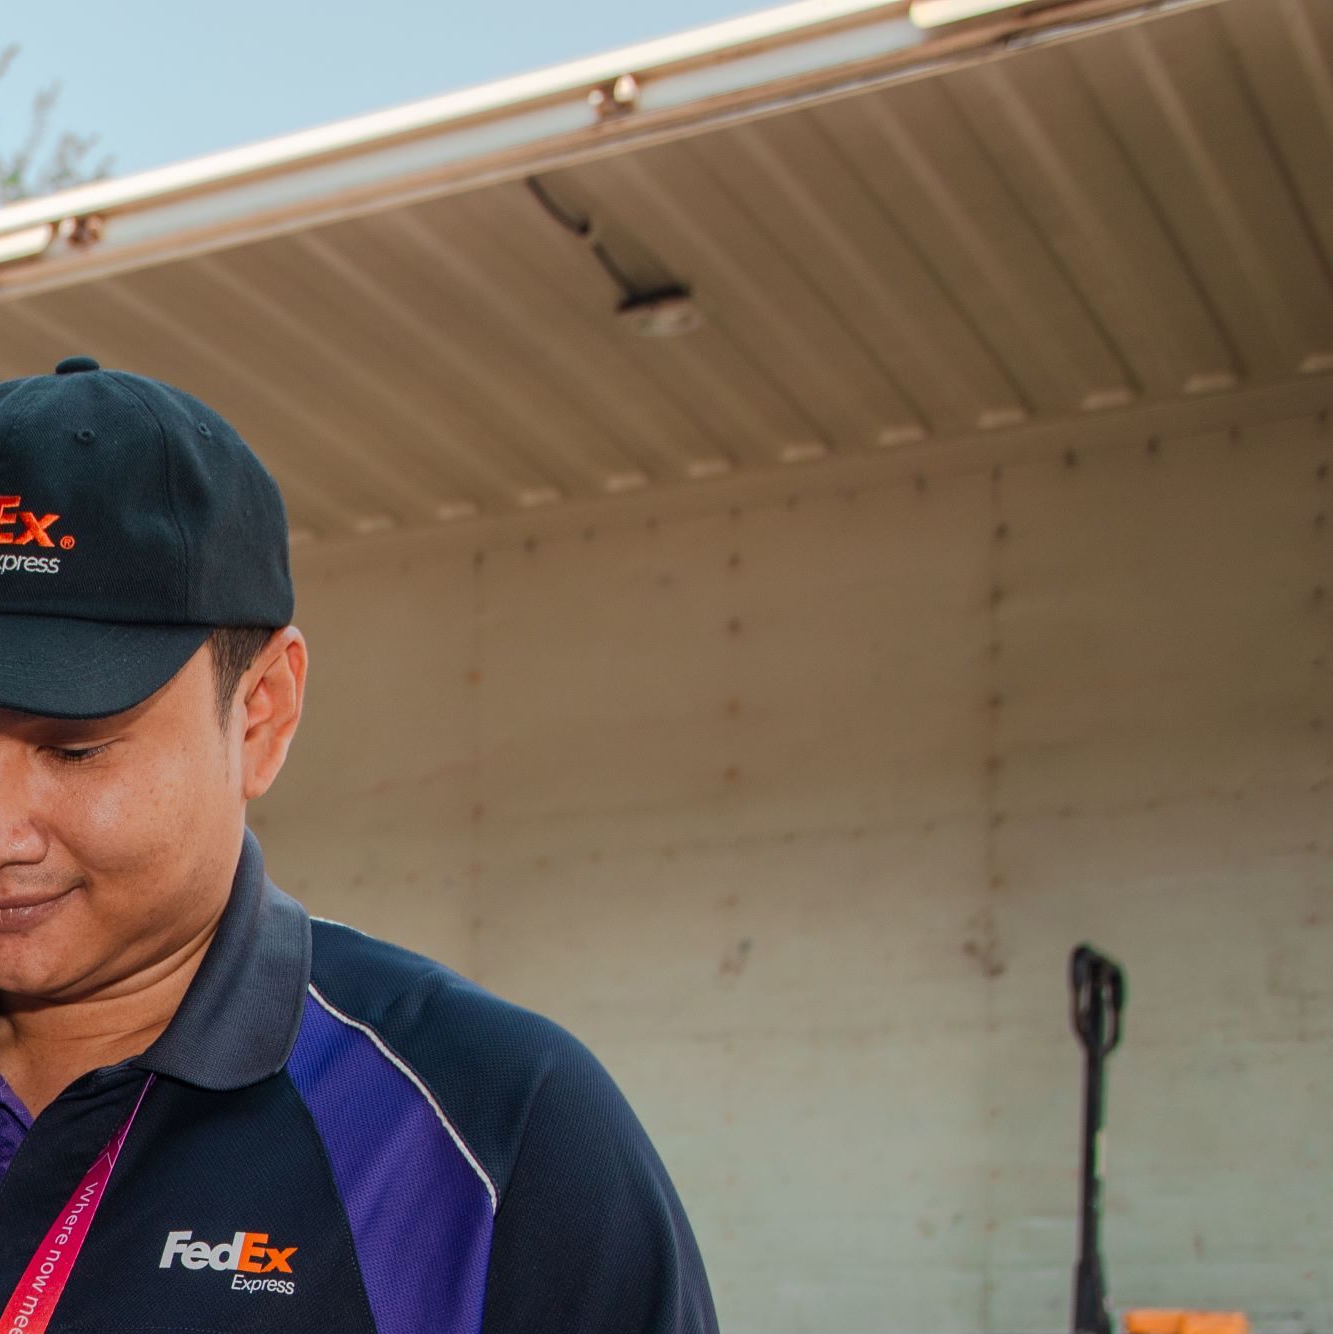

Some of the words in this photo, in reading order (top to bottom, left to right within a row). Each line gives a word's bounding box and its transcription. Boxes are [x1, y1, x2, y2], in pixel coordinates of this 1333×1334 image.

[54, 1182, 99, 1245] Where
[31, 1249, 62, 1293] now
[159, 1230, 299, 1274] FedEx
[231, 1274, 295, 1295] Express
